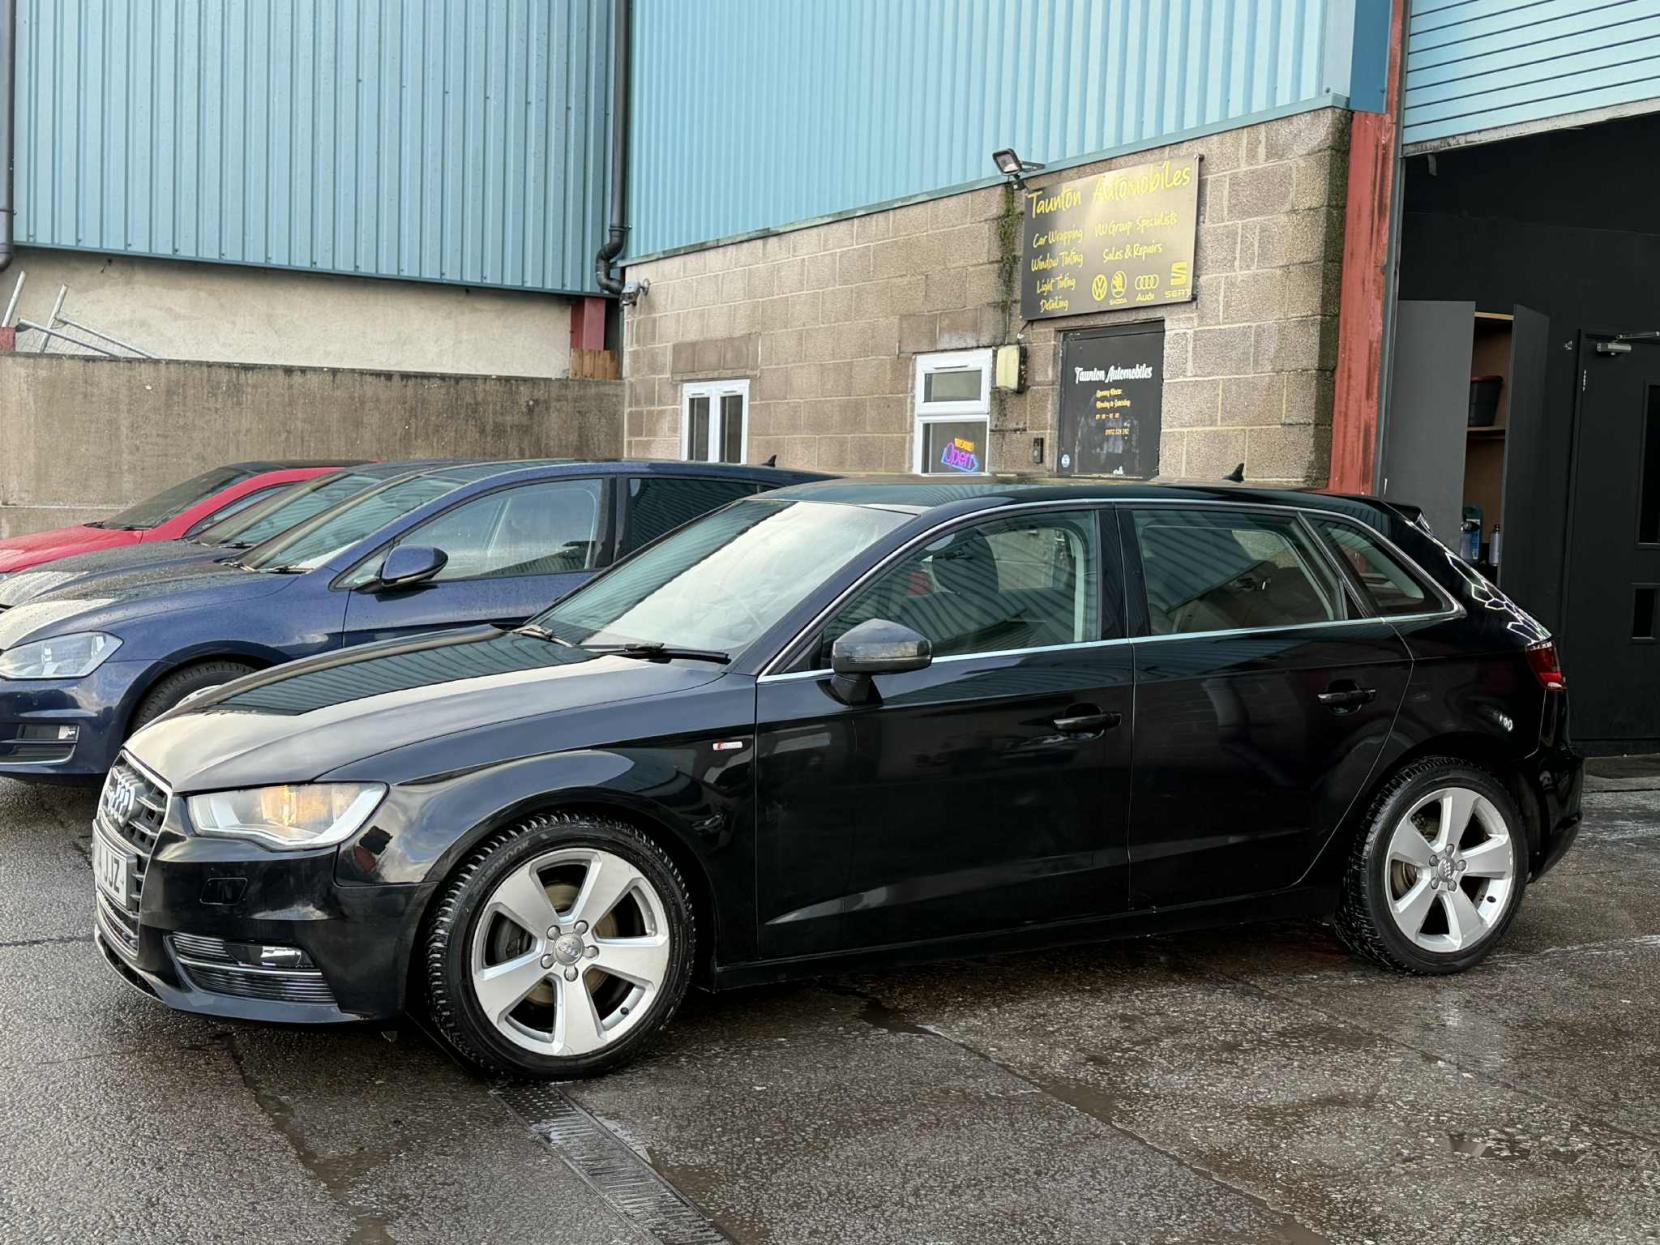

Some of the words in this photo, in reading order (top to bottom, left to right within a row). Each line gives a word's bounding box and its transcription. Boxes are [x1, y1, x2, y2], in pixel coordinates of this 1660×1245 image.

[1027, 187, 1082, 220] Taunton
[1093, 160, 1191, 203] Automobiles
[1108, 219, 1133, 237] Group
[1136, 209, 1178, 234] Specialists
[1032, 233, 1048, 248] Car
[1048, 224, 1084, 246] Wrapping
[1031, 252, 1059, 272] Window
[1103, 246, 1124, 263] Sales
[1124, 244, 1132, 259] &
[1133, 239, 1163, 261] Repairs
[1036, 277, 1055, 296] Light
[1136, 291, 1155, 302] Audi
[1040, 295, 1069, 313] Detailing
[1074, 366, 1105, 384] Taunton
[1105, 363, 1153, 383] Automobiles
[944, 442, 971, 470] Open
